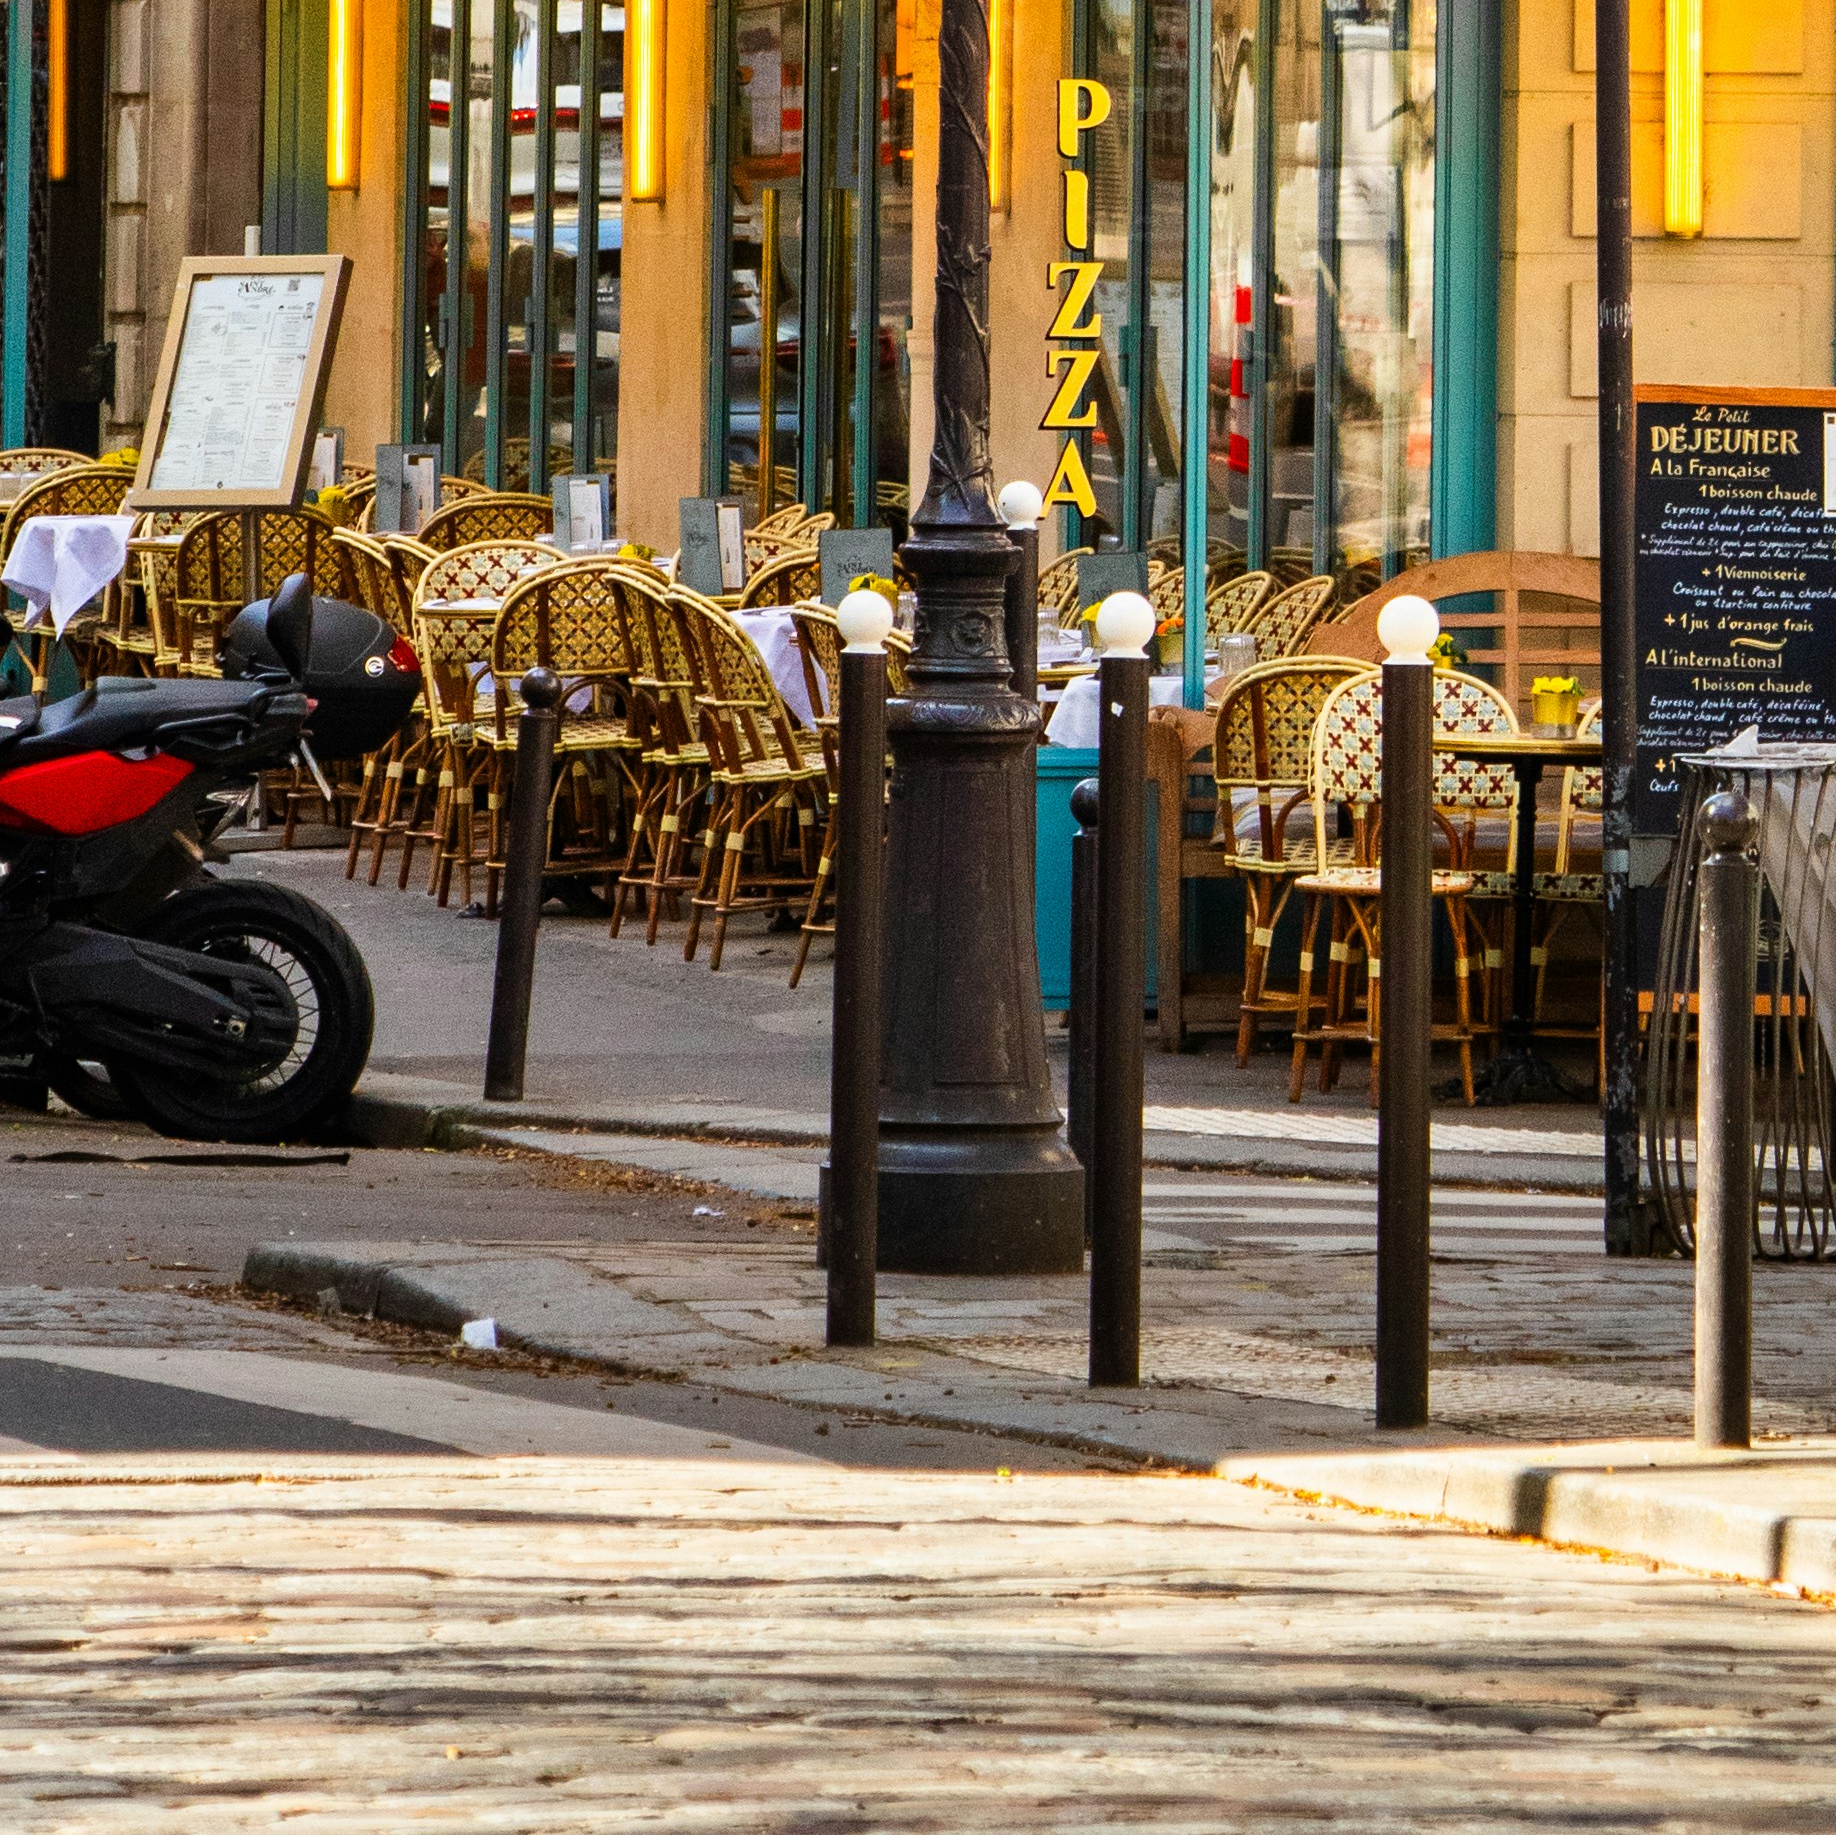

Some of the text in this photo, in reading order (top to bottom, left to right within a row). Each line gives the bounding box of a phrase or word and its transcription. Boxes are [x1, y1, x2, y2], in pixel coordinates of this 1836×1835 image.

[1039, 78, 1112, 519] PIZZA
[1692, 406, 1750, 423] Le Petit
[1650, 423, 1801, 455] DÉJEUNER
[1651, 458, 1771, 479] A la Française
[1767, 484, 1818, 501] chaude
[1720, 504, 1755, 516] double
[1661, 519, 1705, 530] chocolat
[1673, 581, 1723, 596] Croissant
[1732, 589, 1745, 597] ou
[1752, 585, 1776, 598] Pain
[1780, 590, 1794, 599] au
[1762, 599, 1813, 610] confiture
[1718, 616, 1779, 634] d'orange
[1783, 619, 1814, 632] frais
[1645, 649, 1783, 669] A l'international
[1759, 679, 1813, 693] chaude
[1700, 698, 1734, 709] double
[1648, 710, 1692, 720] chocolat
[1738, 712, 1766, 723] café
[1805, 717, 1818, 725] ou
